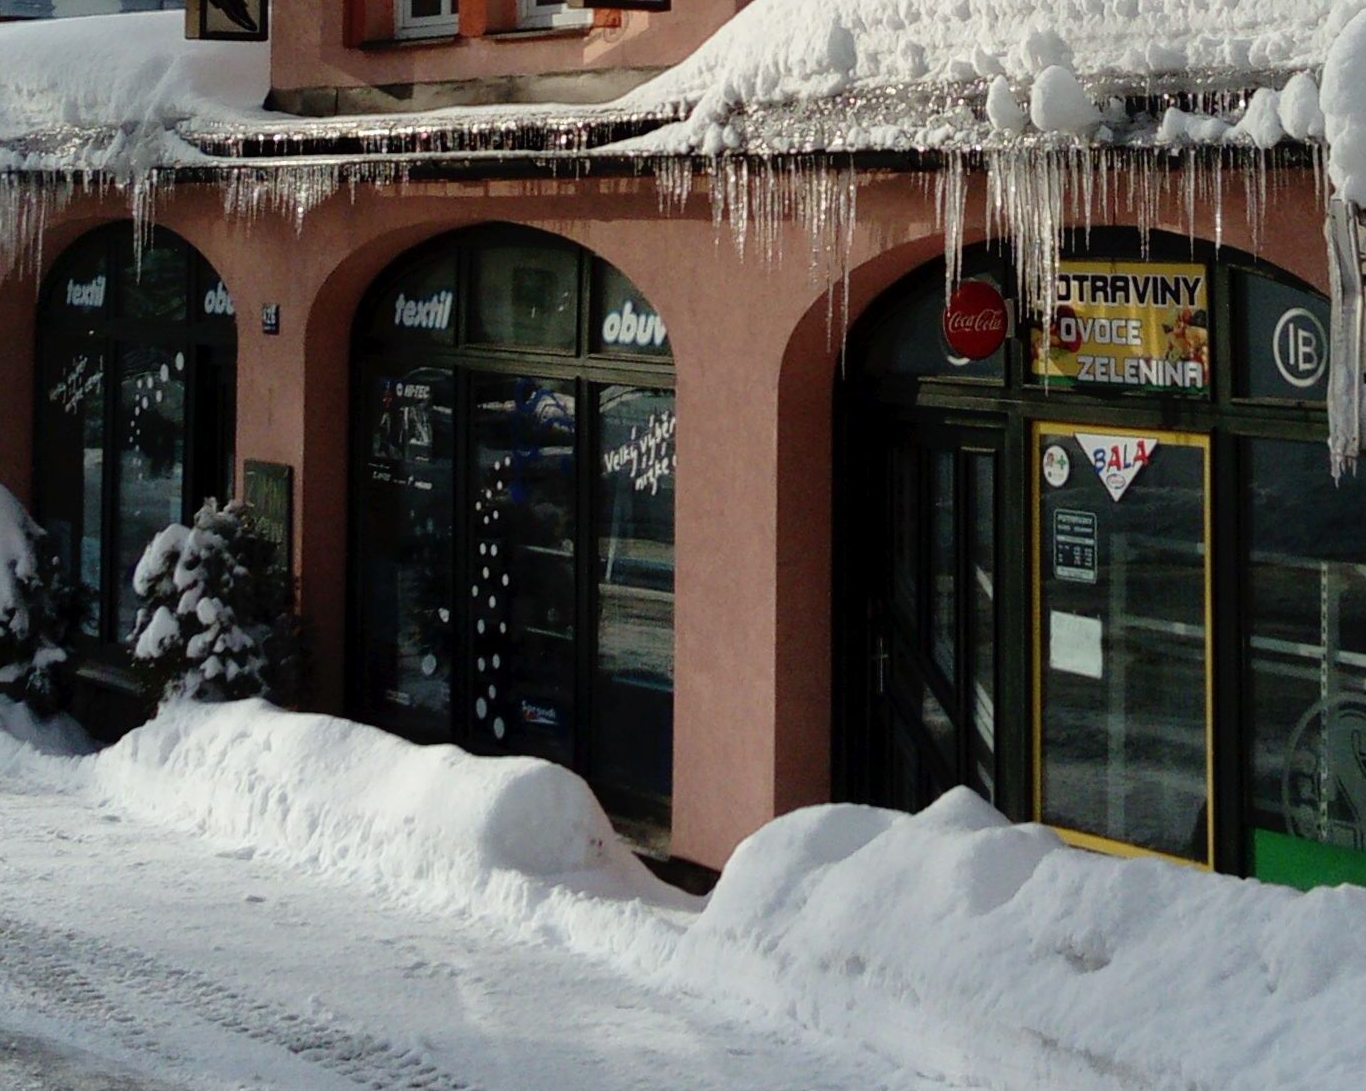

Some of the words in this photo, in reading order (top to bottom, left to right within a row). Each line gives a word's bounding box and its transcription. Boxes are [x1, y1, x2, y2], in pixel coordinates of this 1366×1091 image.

[65, 275, 106, 308] textil
[394, 290, 454, 330] textil
[1059, 316, 1142, 346] OVOCE
[1077, 355, 1204, 389] ZELENINA
[1093, 439, 1152, 477] BALA
